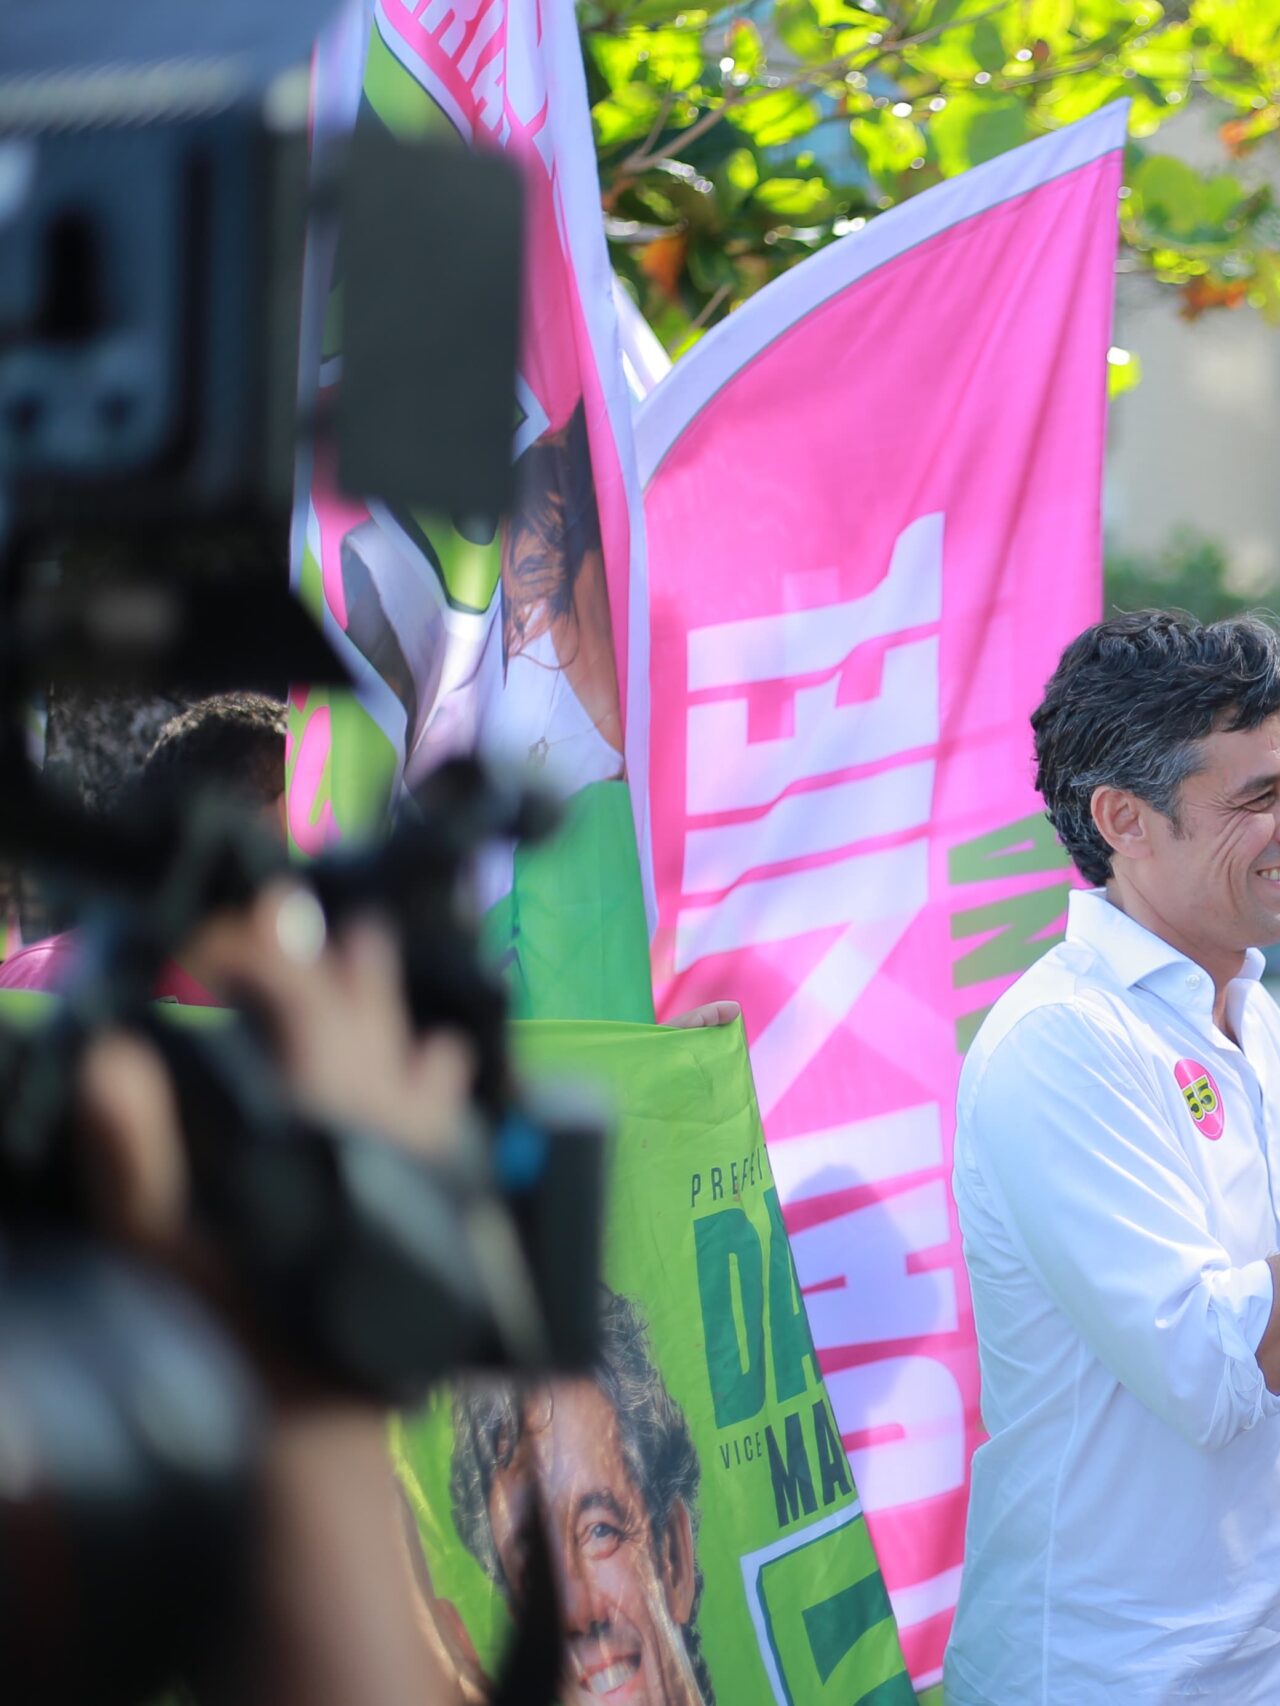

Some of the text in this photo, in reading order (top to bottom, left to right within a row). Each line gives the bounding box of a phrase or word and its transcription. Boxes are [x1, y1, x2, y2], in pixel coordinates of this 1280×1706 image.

[1182, 1074, 1219, 1121] 55
[690, 1143, 767, 1208] PREFEI
[719, 1431, 762, 1470] VICE
